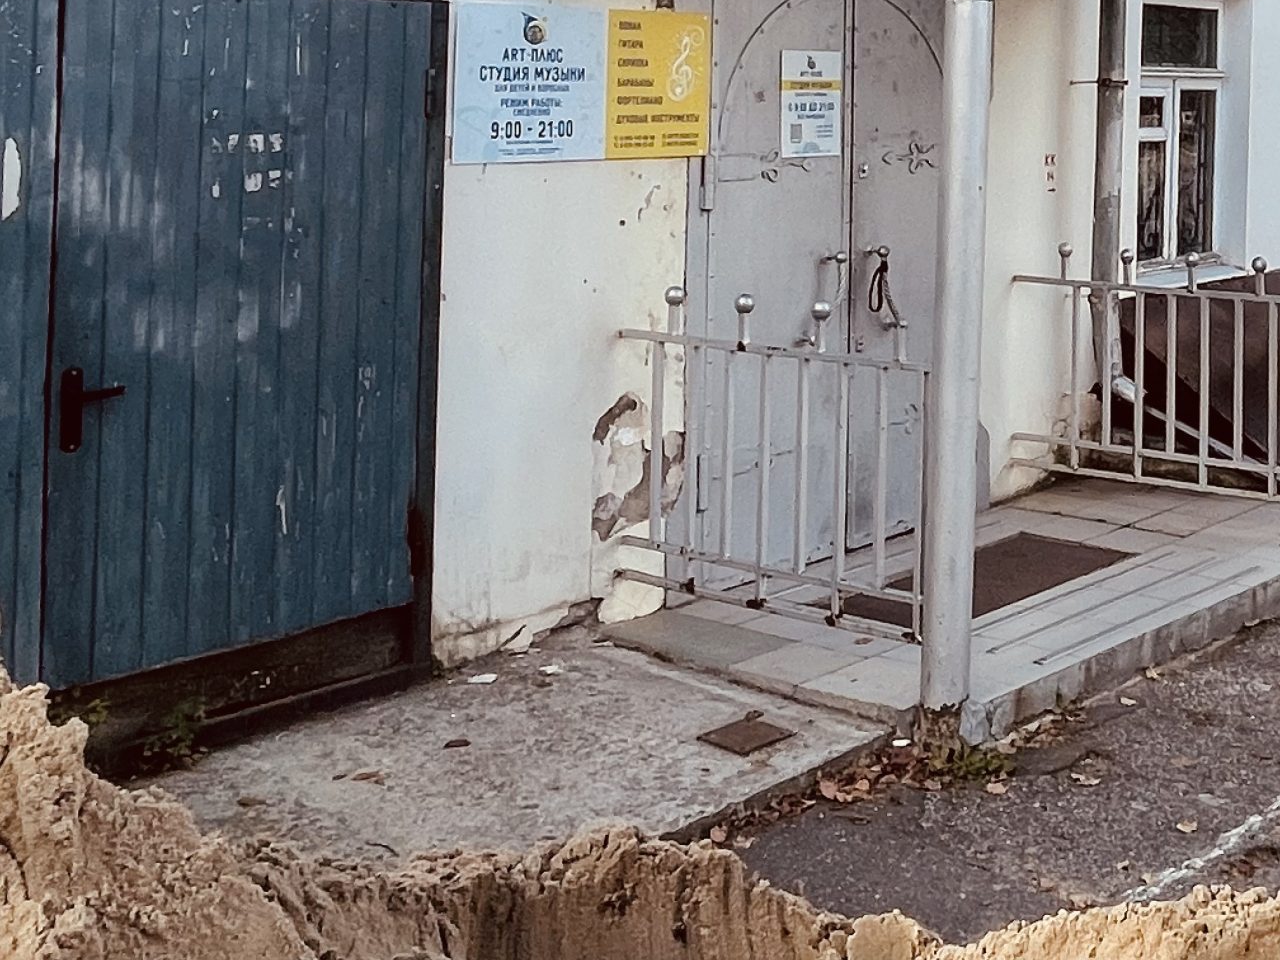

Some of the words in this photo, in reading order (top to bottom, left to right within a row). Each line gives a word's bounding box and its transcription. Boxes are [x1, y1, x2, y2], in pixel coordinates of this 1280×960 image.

[480, 65, 529, 82] СТУДИЯ
[534, 66, 585, 82] МУЗЫКИ
[490, 121, 521, 140] 9:00
[538, 120, 573, 138] 21:00
